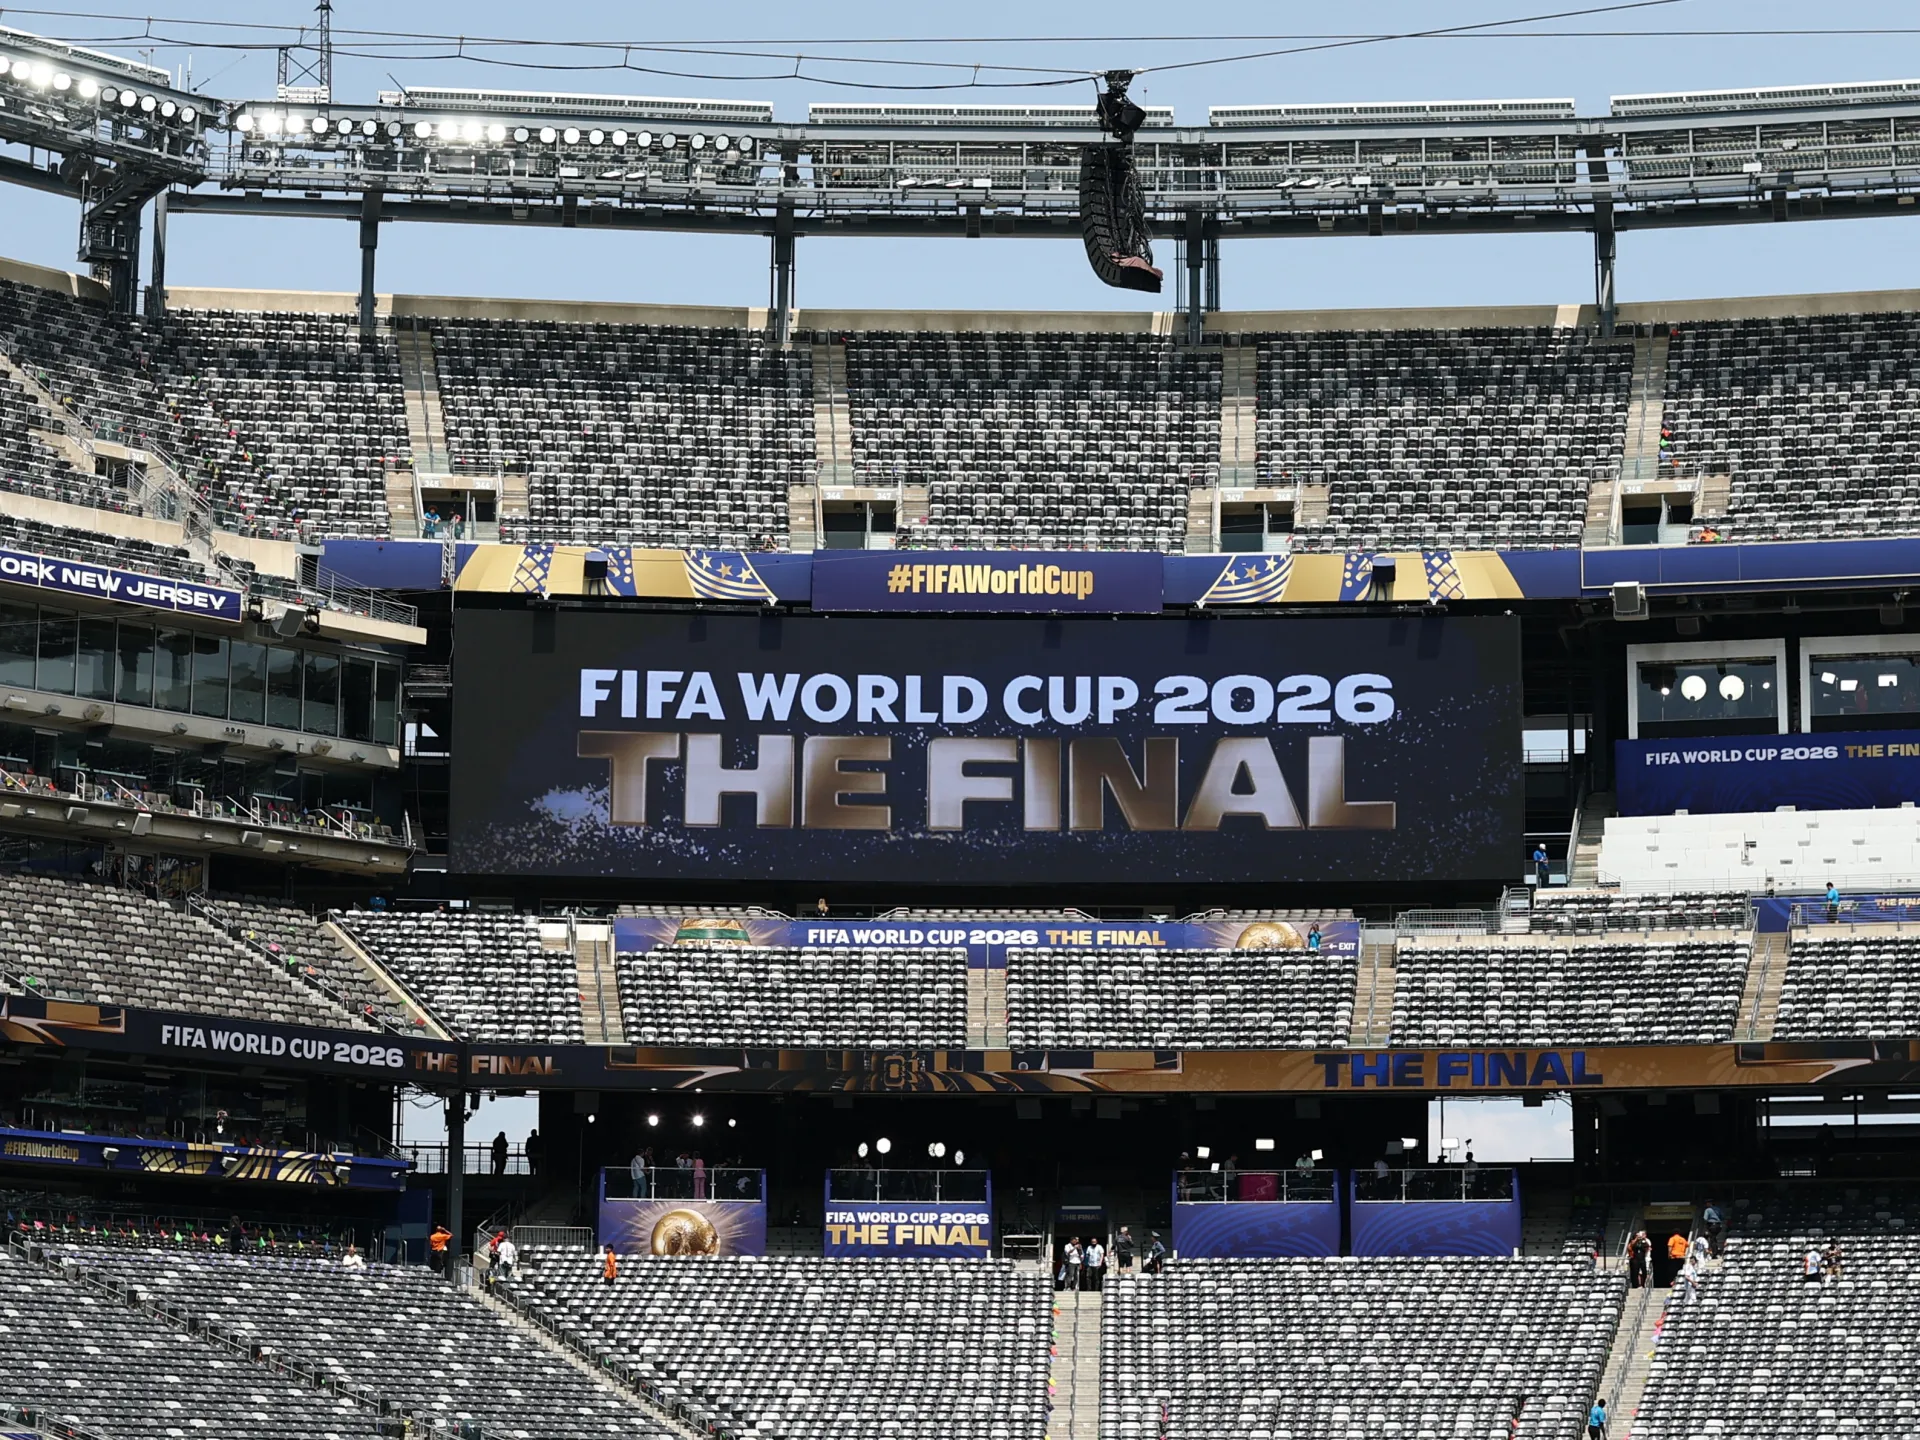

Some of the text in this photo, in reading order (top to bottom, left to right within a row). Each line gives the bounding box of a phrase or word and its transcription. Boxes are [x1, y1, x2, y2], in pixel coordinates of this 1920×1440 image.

[877, 491, 892, 500] 347
[1626, 485, 1641, 493] 348
[1677, 483, 1692, 491] 349
[0, 556, 226, 610] ORK NEW JERSEY
[888, 564, 1093, 599] #FIFAWorldCup
[579, 668, 1395, 725] FIFA WORLD CUP 2026
[1646, 752, 1680, 765] FIFA
[1683, 750, 1742, 764] WORLD
[1745, 748, 1778, 762] CUP
[1780, 746, 1838, 761] 2026
[1844, 744, 1884, 758] THE
[577, 730, 1397, 832] THE FINAL
[1875, 898, 1897, 907] THE
[808, 929, 1165, 946] FIFA WORLD CUP 2026 THE FINAL
[1338, 942, 1355, 951] EXIT
[162, 1024, 562, 1075] FIFA WORLD CUP 2026 THE FINAL
[1314, 1051, 1603, 1087] THE FINAL
[4, 1140, 79, 1162] #FIFAWorldCup
[826, 1211, 989, 1224] FIFA WORLD CUP 2026
[1061, 1213, 1101, 1221] THE FINAL
[826, 1224, 989, 1247] THE FINAL
